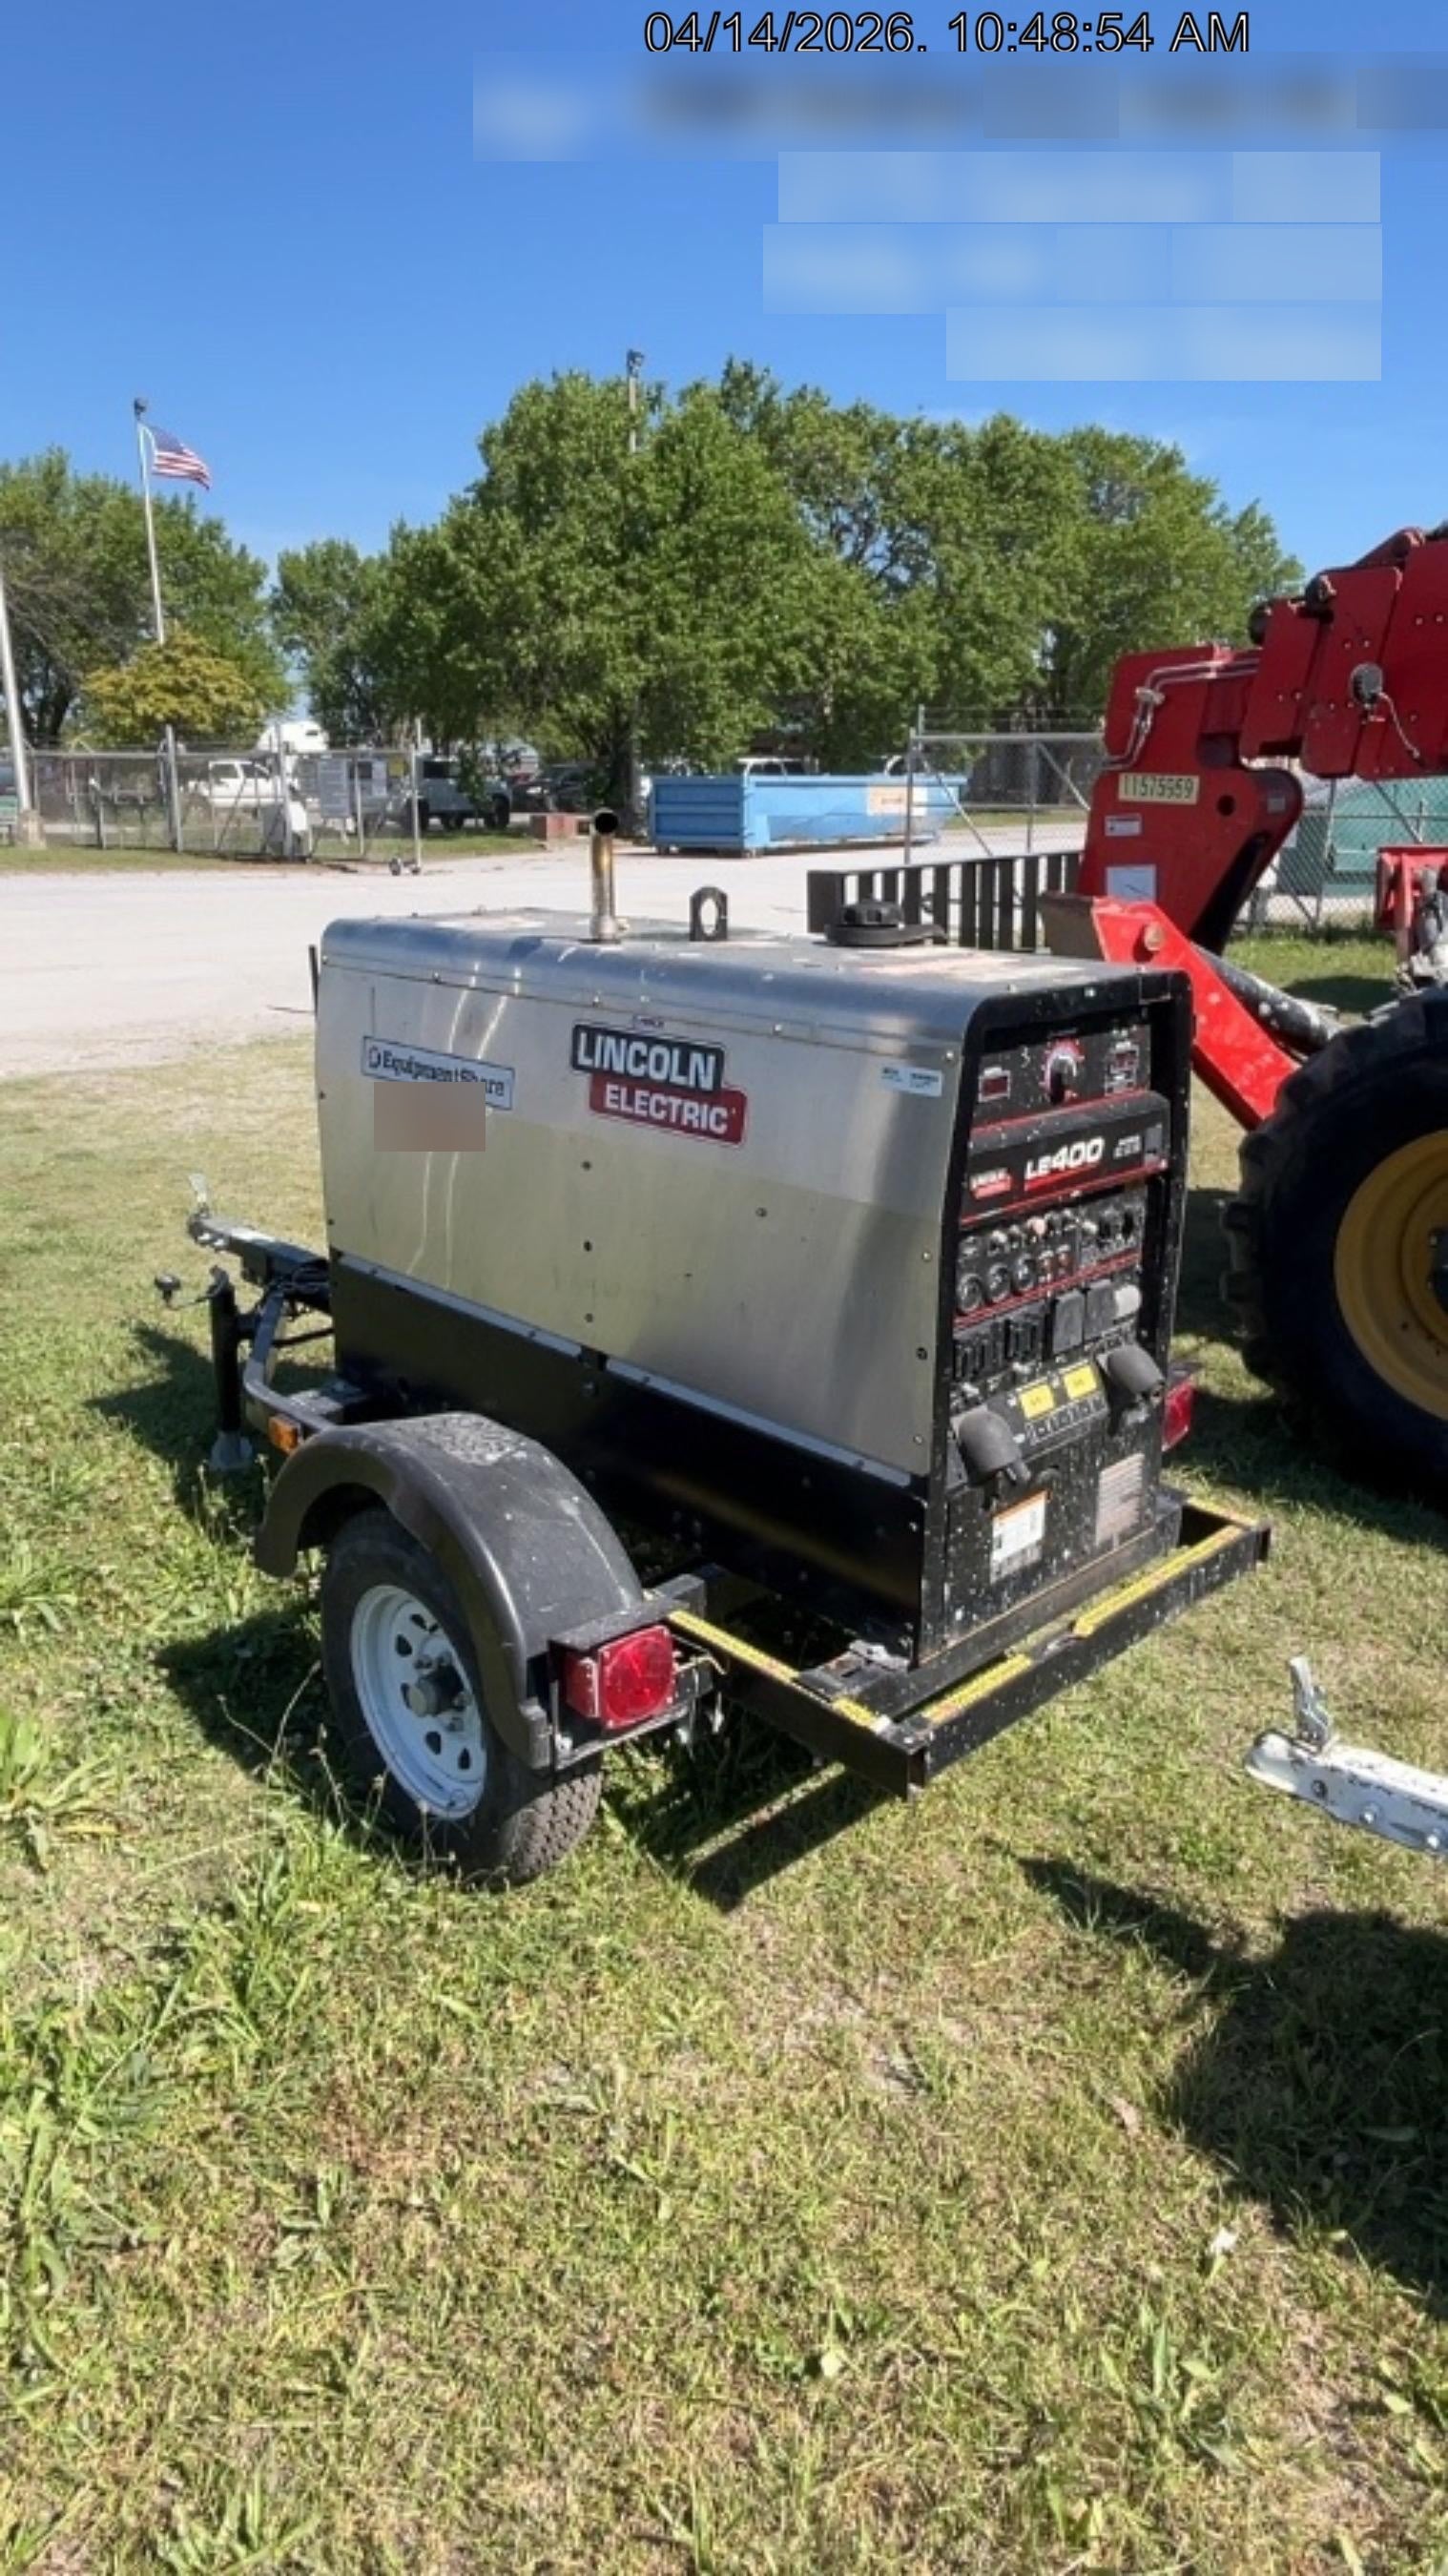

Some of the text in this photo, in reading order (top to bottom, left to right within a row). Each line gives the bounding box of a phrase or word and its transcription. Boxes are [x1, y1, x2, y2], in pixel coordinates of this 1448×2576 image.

[577, 1030, 715, 1091] LINCOLN
[605, 1083, 729, 1135] ELECTRIC
[1024, 1135, 1106, 1180] LE400
